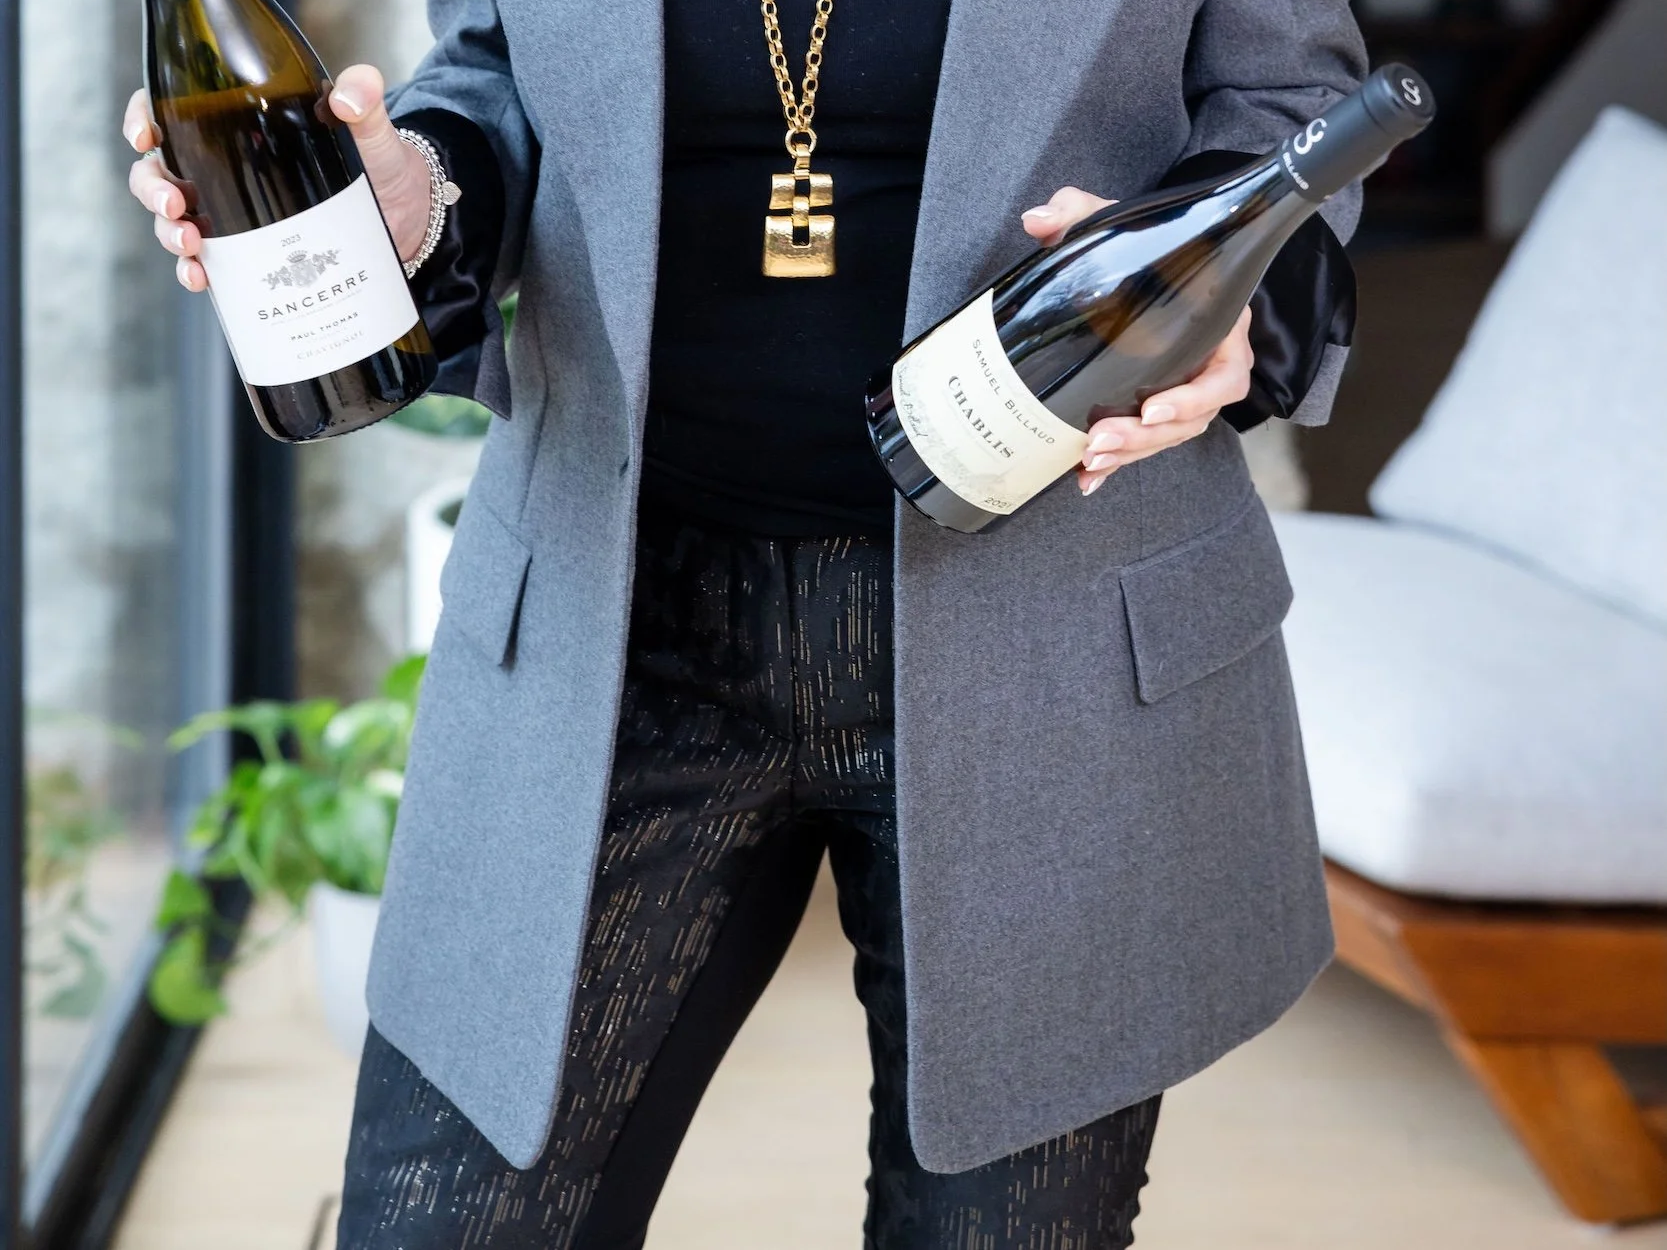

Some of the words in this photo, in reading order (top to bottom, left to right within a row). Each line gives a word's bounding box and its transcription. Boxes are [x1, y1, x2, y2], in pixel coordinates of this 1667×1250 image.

[257, 269, 369, 320] SANCERRE
[290, 331, 316, 341] PAUL
[319, 311, 359, 332] THOMAS
[948, 375, 1014, 459] CHABLIS
[972, 338, 1000, 395] SAMUEL
[1004, 399, 1055, 445] BILLAUD
